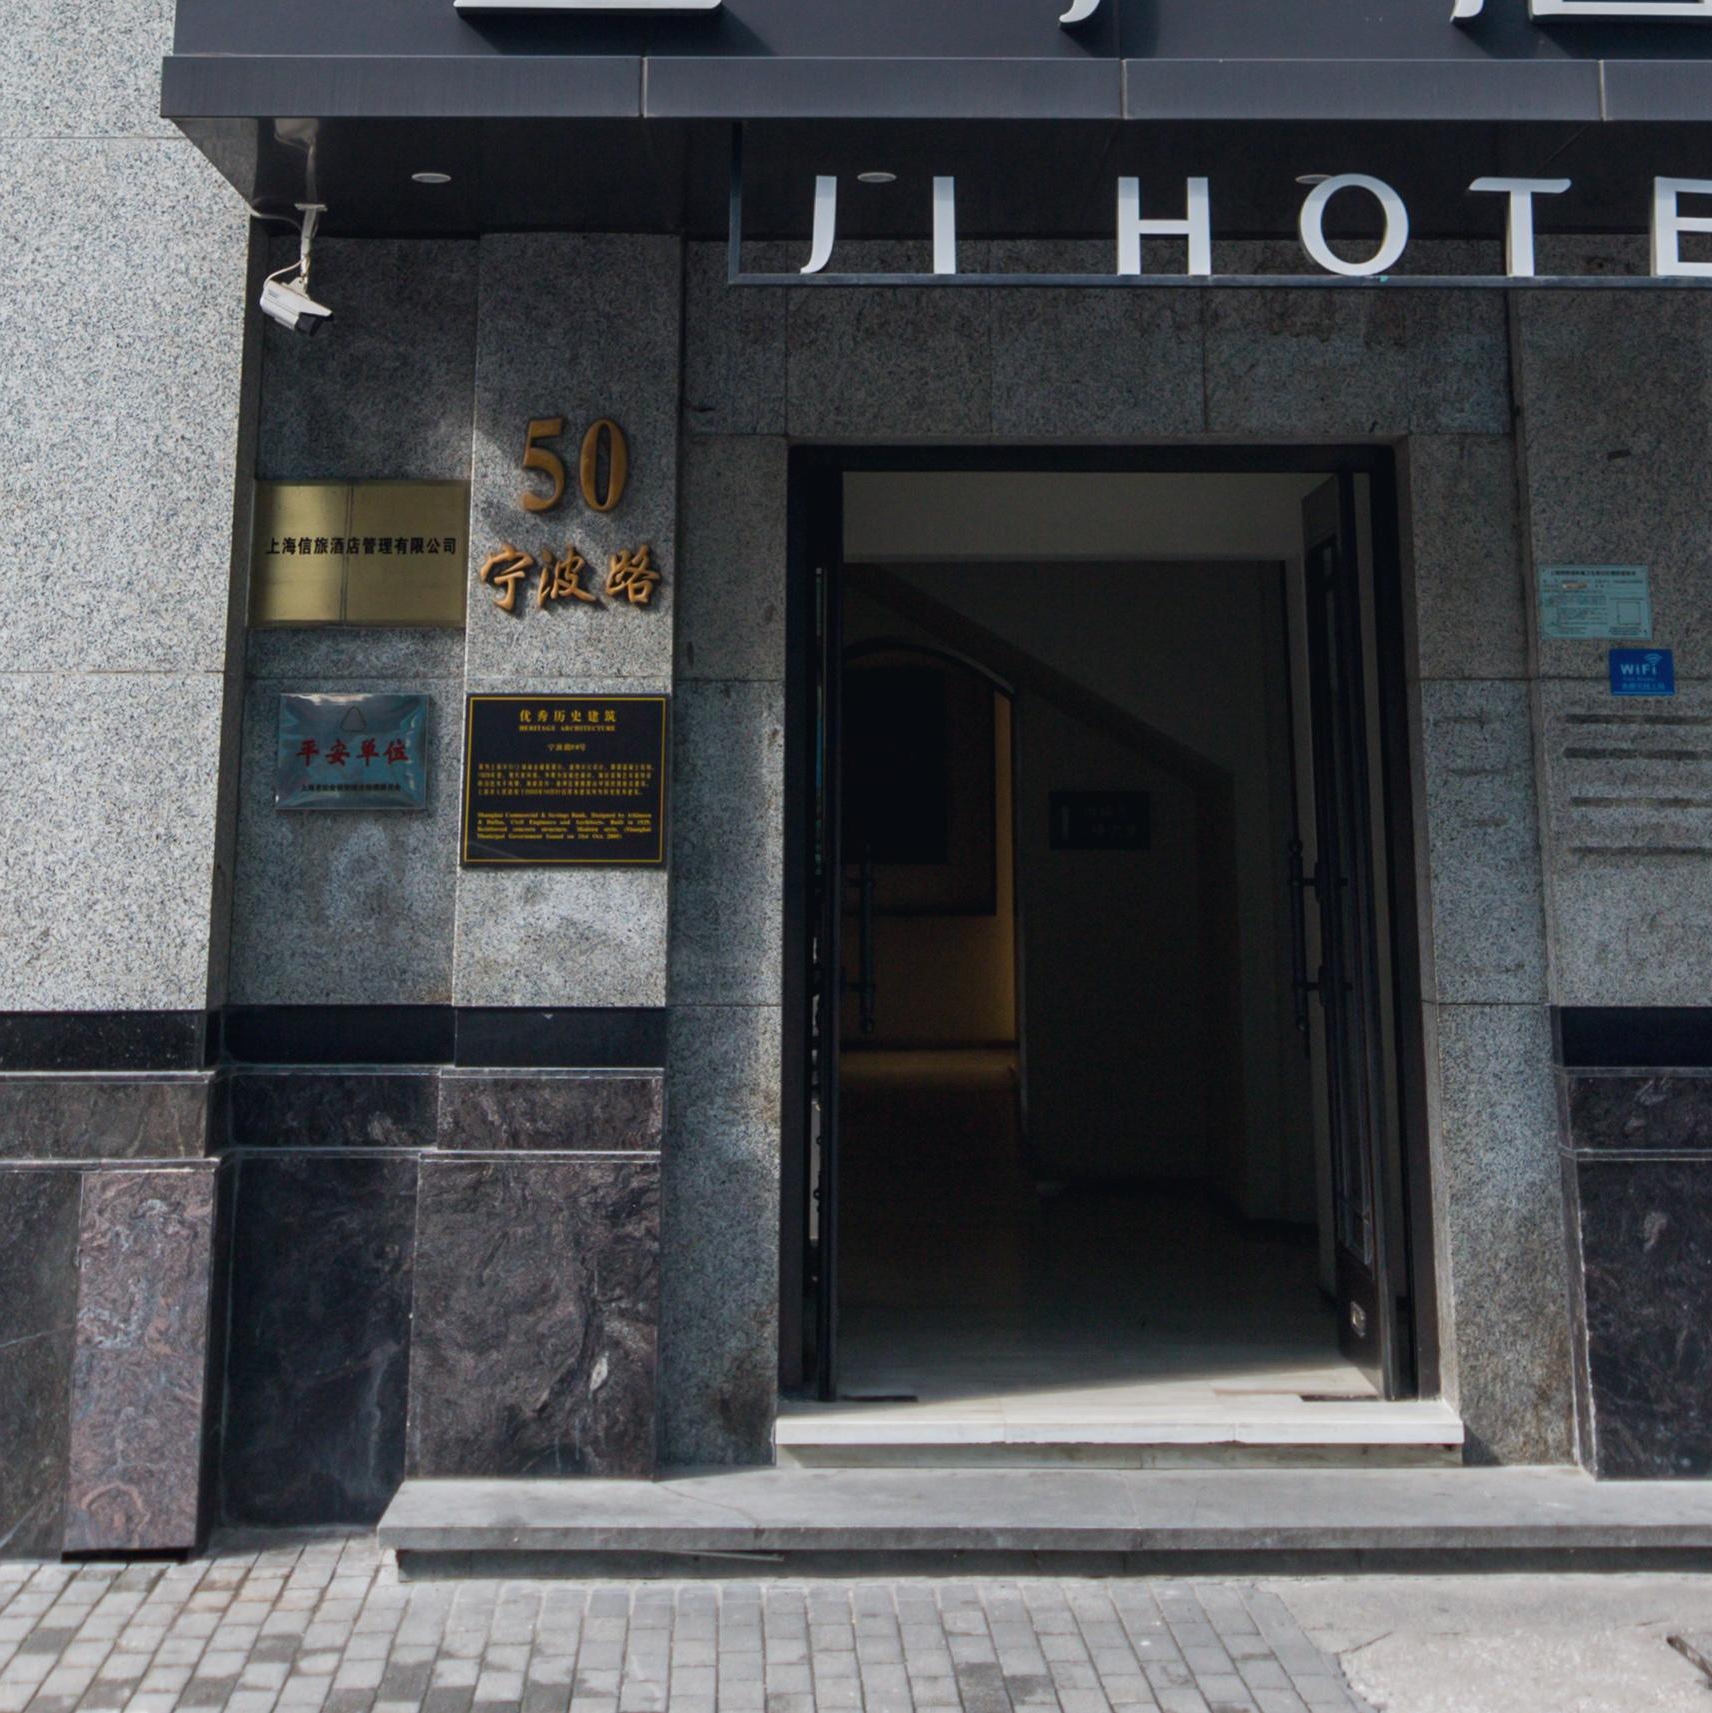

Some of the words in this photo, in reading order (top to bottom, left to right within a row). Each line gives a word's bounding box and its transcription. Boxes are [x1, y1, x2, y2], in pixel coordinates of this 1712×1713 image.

[799, 175, 957, 276] JI
[519, 418, 627, 512] 50
[266, 536, 457, 555] 上海信旅酒店管理有限公司
[479, 543, 661, 613] 宁波路
[519, 709, 617, 723] 优秀历史建筑
[296, 738, 409, 768] 平安单位
